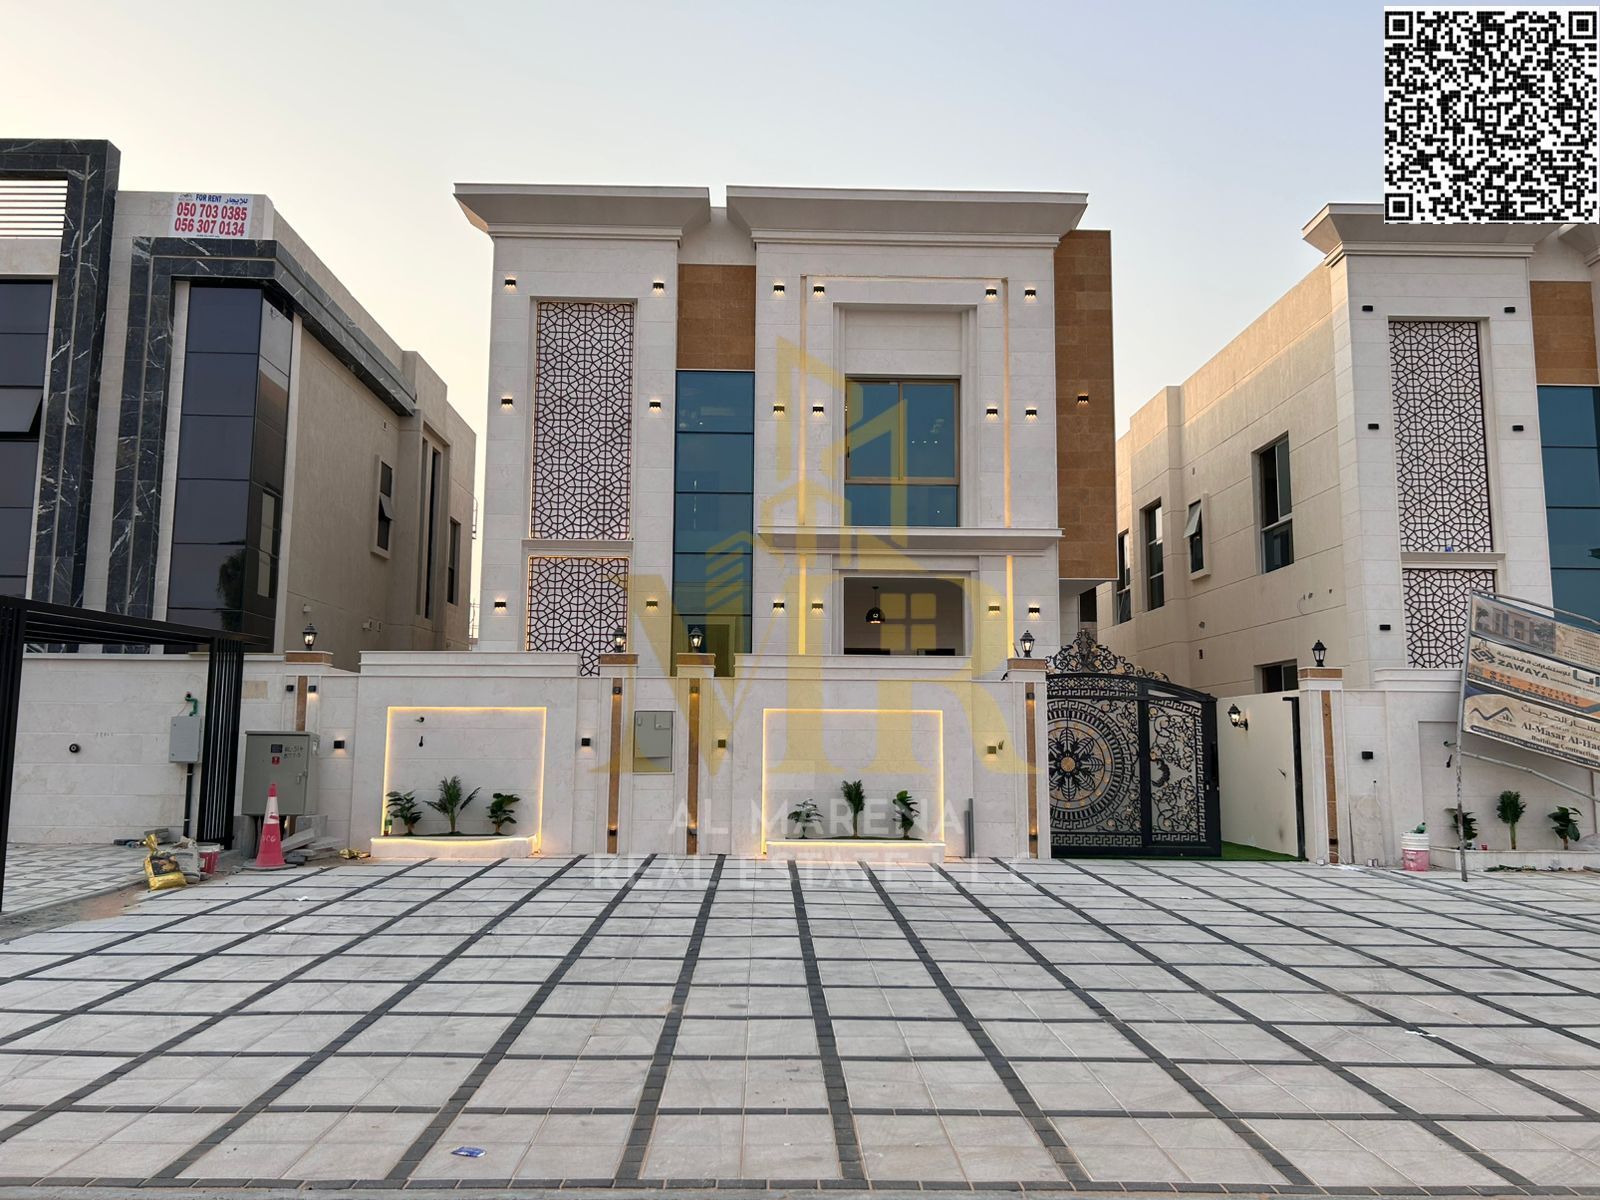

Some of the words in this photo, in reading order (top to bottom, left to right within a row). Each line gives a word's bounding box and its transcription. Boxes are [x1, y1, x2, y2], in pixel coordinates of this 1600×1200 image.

[196, 193, 207, 201] FOR
[208, 194, 222, 203] RENT
[177, 202, 196, 217] 050
[199, 204, 219, 219] 703
[221, 205, 247, 221] 0385
[175, 217, 195, 232] 056
[196, 219, 217, 234] 307
[219, 221, 245, 236] 0134
[1497, 659, 1550, 681] ZAWAYA
[1521, 722, 1566, 742] Al-Masar
[1531, 734, 1560, 749] Building
